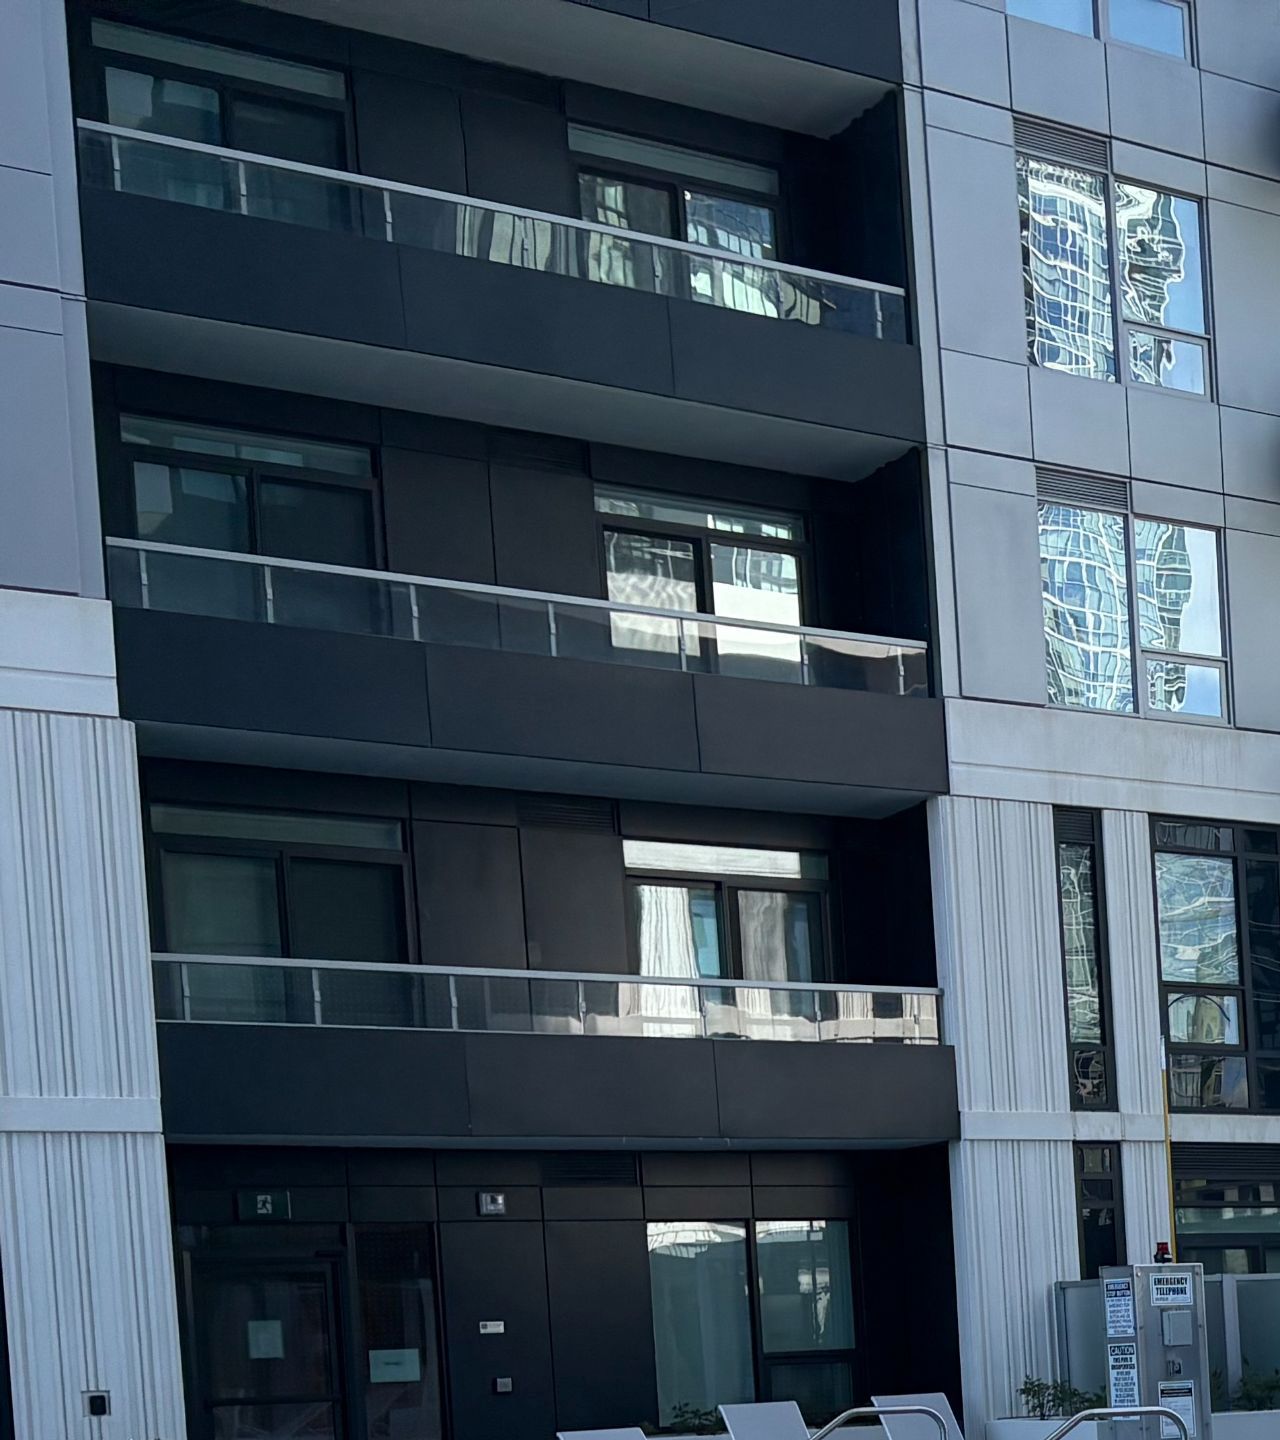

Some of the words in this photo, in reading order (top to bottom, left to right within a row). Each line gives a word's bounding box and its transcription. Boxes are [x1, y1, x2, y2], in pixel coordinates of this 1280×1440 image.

[1153, 1276, 1188, 1286] EMERGENCY
[1155, 1286, 1188, 1296] TELEPHONE
[1110, 1345, 1135, 1355] CAUTION
